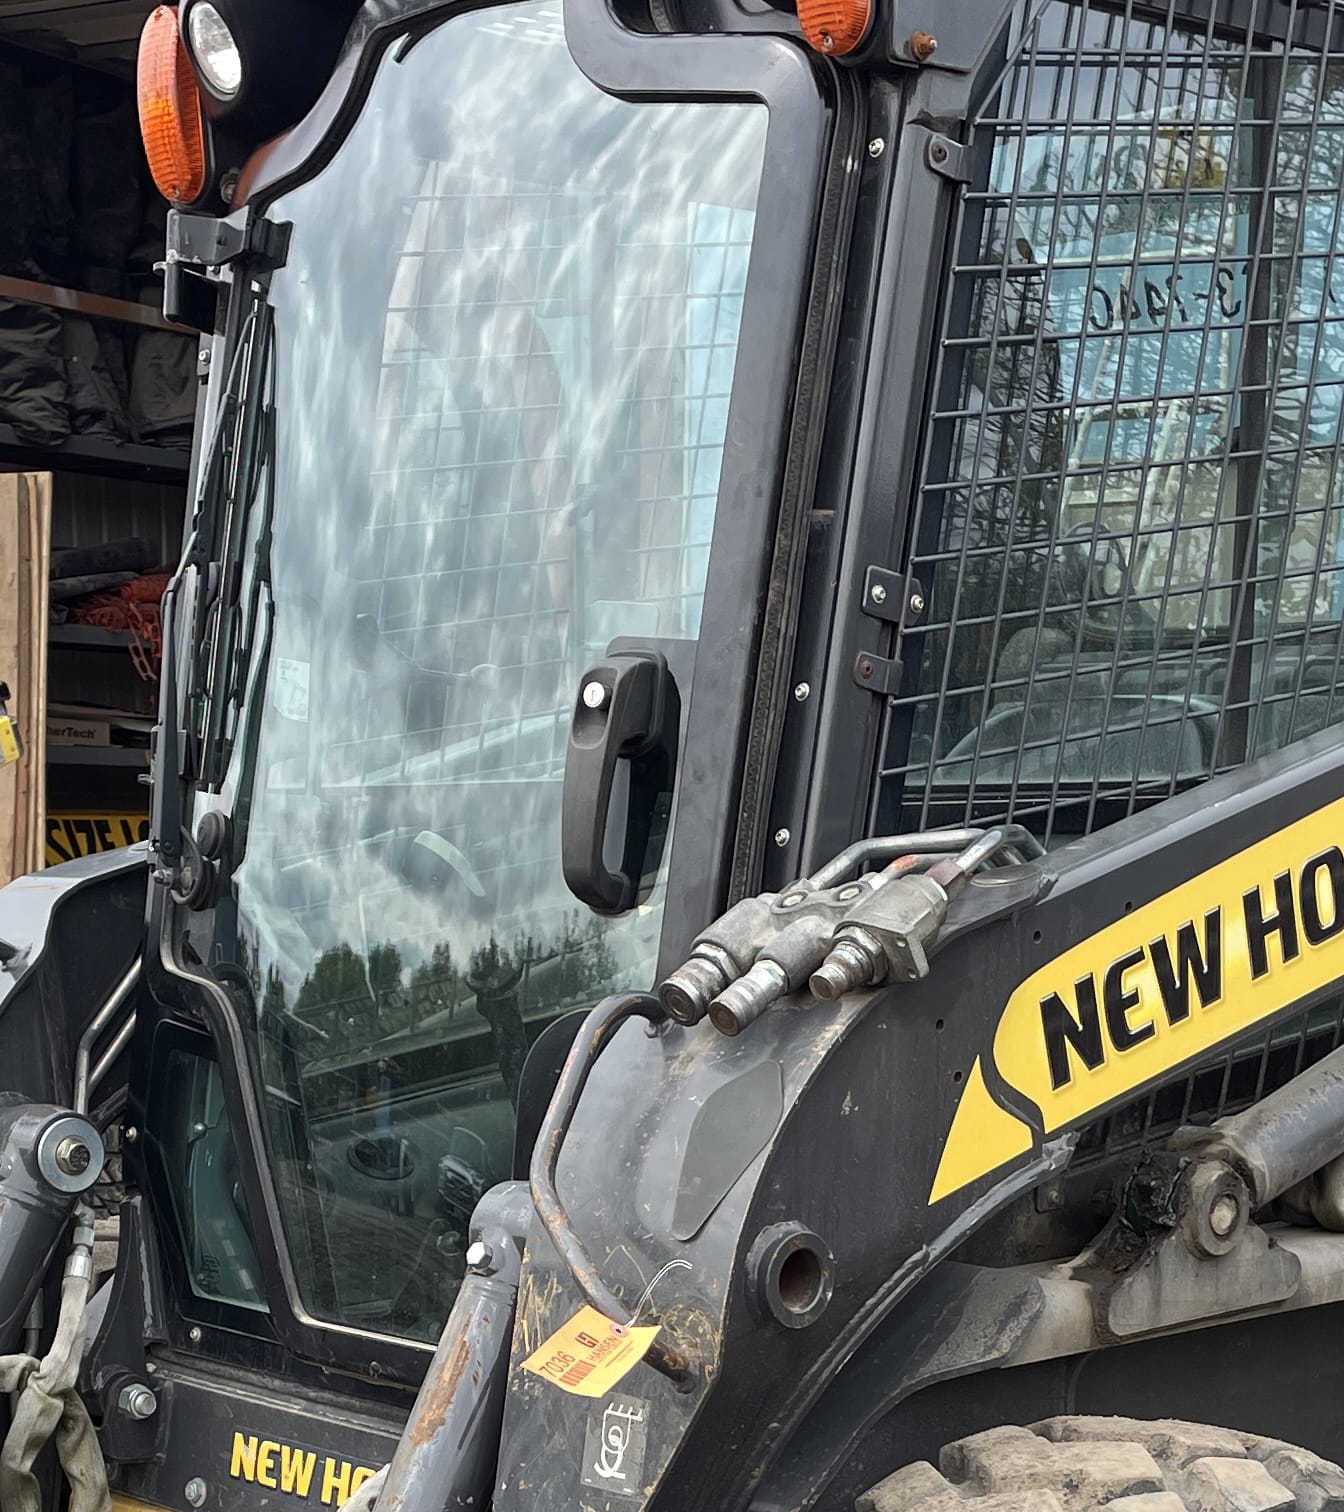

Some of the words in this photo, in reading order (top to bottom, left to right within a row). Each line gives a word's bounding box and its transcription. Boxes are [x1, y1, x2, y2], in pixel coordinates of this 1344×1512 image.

[1038, 904, 1223, 1091] NEW
[538, 1350, 577, 1379] 7036
[586, 1336, 618, 1361] HANSEN
[230, 1431, 317, 1498] NEW
